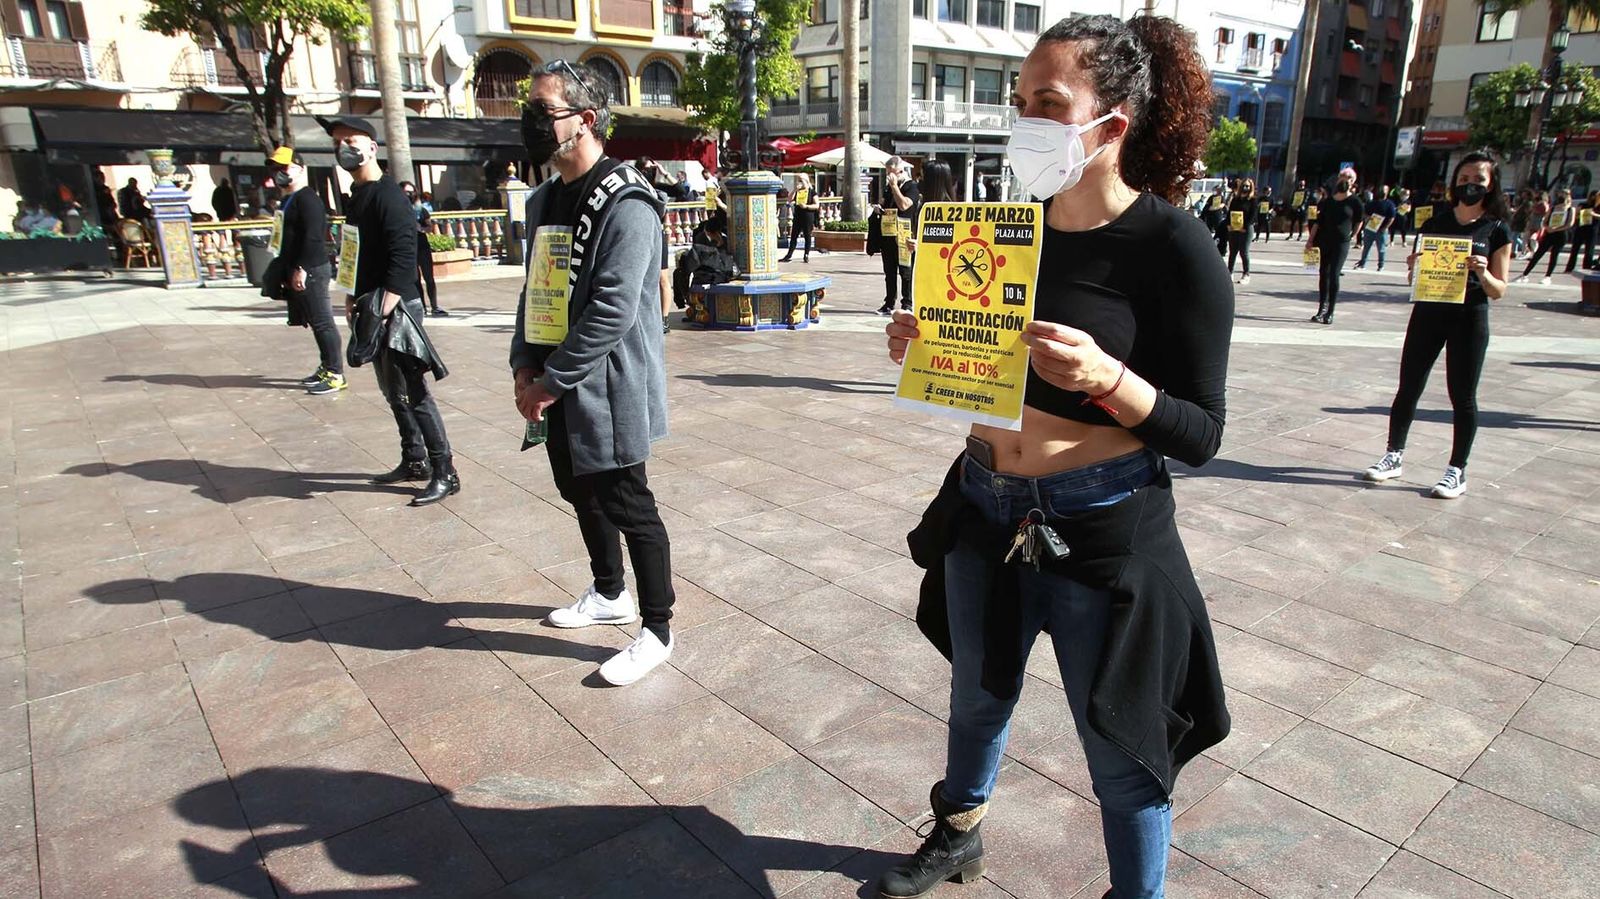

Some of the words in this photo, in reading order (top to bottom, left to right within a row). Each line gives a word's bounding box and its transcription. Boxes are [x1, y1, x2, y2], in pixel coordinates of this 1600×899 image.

[925, 206, 943, 222] DIA
[947, 206, 963, 222] 22
[965, 206, 982, 222] DE
[985, 206, 1035, 224] MARZO
[923, 226, 953, 237] ALGECIRAS
[995, 228, 1015, 238] PLAZA
[1016, 229, 1033, 239] ALTA
[1004, 286, 1014, 299] 10
[1016, 287, 1025, 300] h.
[919, 306, 1024, 331] CONCENTRACIÓN
[938, 324, 999, 346] NACIONAL
[958, 350, 982, 359] reducción
[922, 369, 941, 377] merece
[930, 355, 954, 372] IVA
[957, 360, 970, 374] al
[973, 361, 999, 379] 10%
[935, 387, 956, 398] CREER
[955, 391, 964, 400] EN
[964, 392, 995, 405] NOSOTROS
